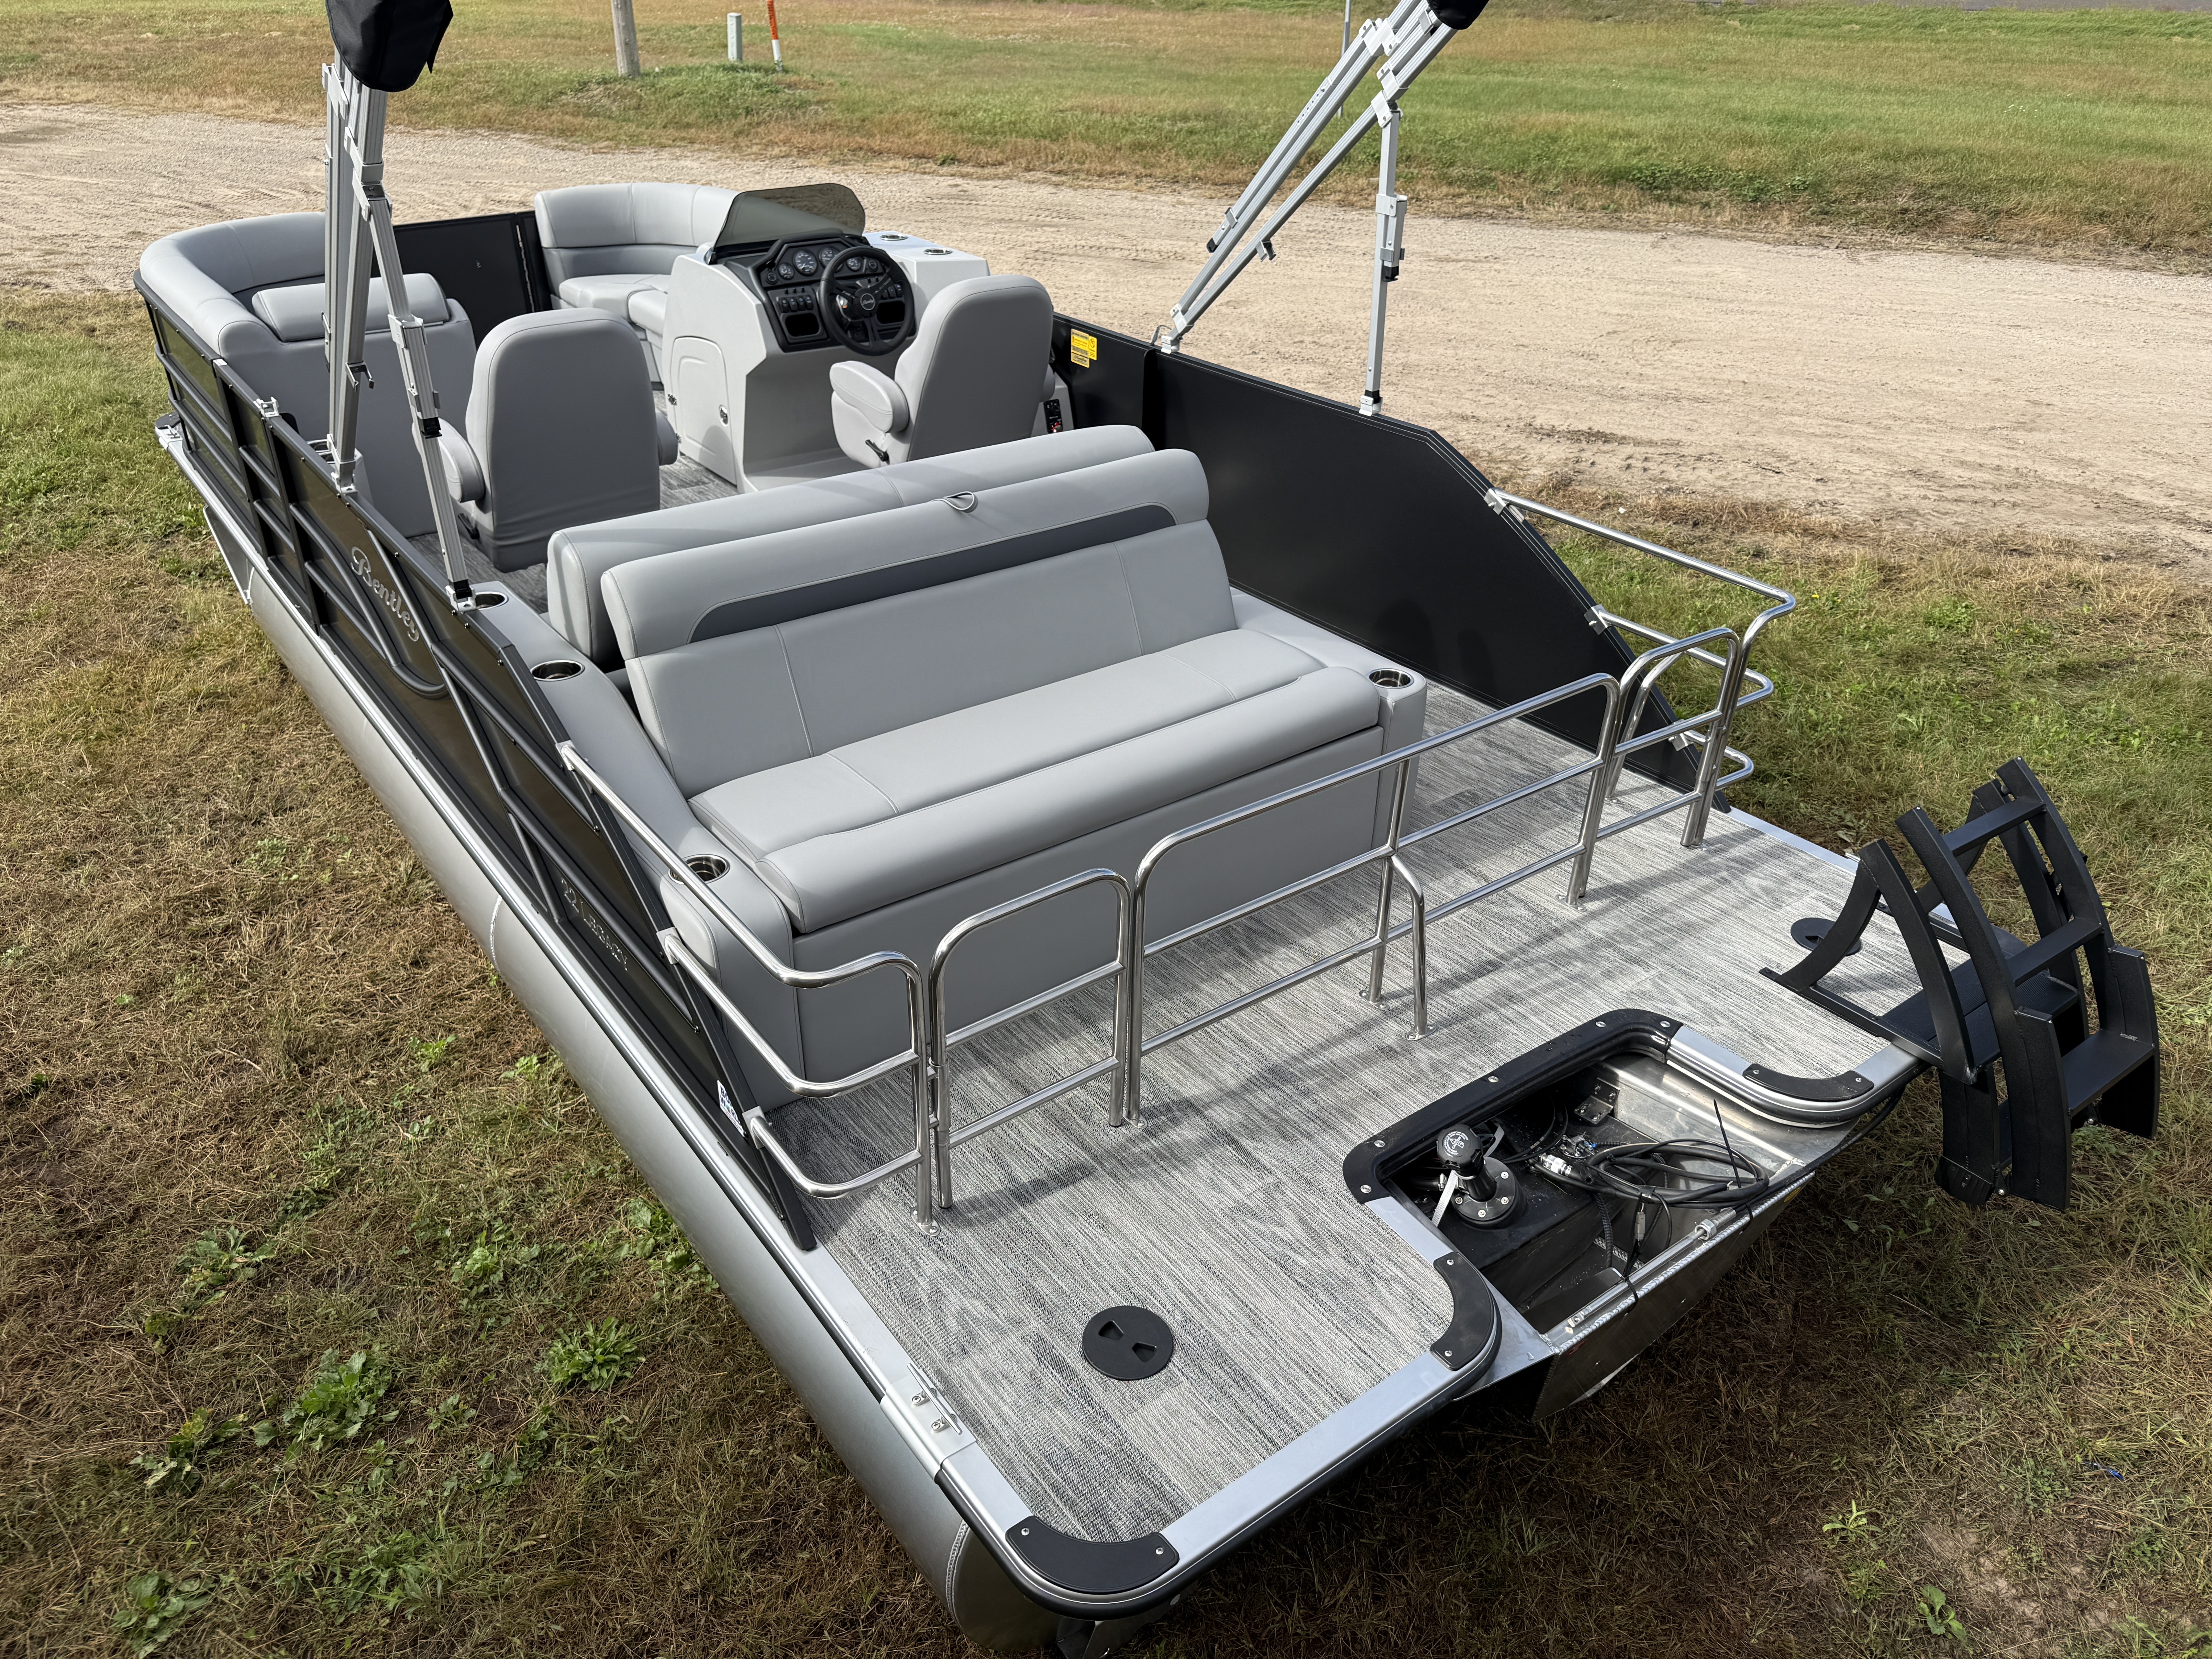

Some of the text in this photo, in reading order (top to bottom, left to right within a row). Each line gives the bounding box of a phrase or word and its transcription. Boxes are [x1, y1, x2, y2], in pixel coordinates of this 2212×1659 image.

[350, 546, 420, 642] Bentley
[561, 877, 628, 971] 22 LEGACY
[720, 1085, 732, 1107] BO
